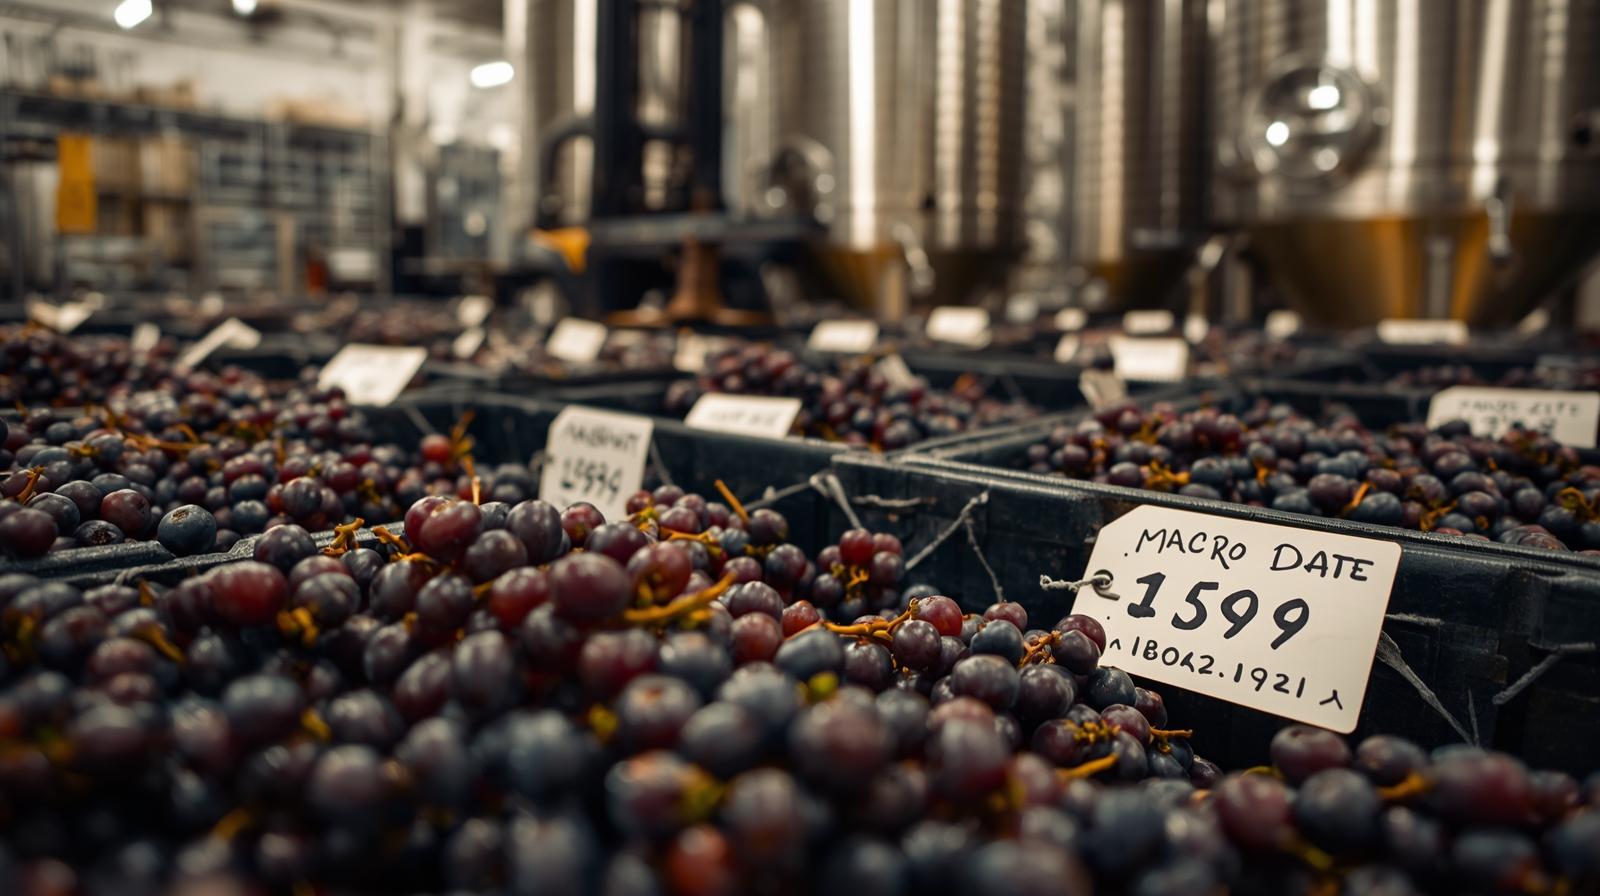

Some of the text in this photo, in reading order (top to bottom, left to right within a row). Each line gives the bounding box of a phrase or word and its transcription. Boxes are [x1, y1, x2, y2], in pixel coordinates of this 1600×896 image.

[1135, 529, 1374, 581] MACRO DATE
[1127, 572, 1309, 650] 1599
